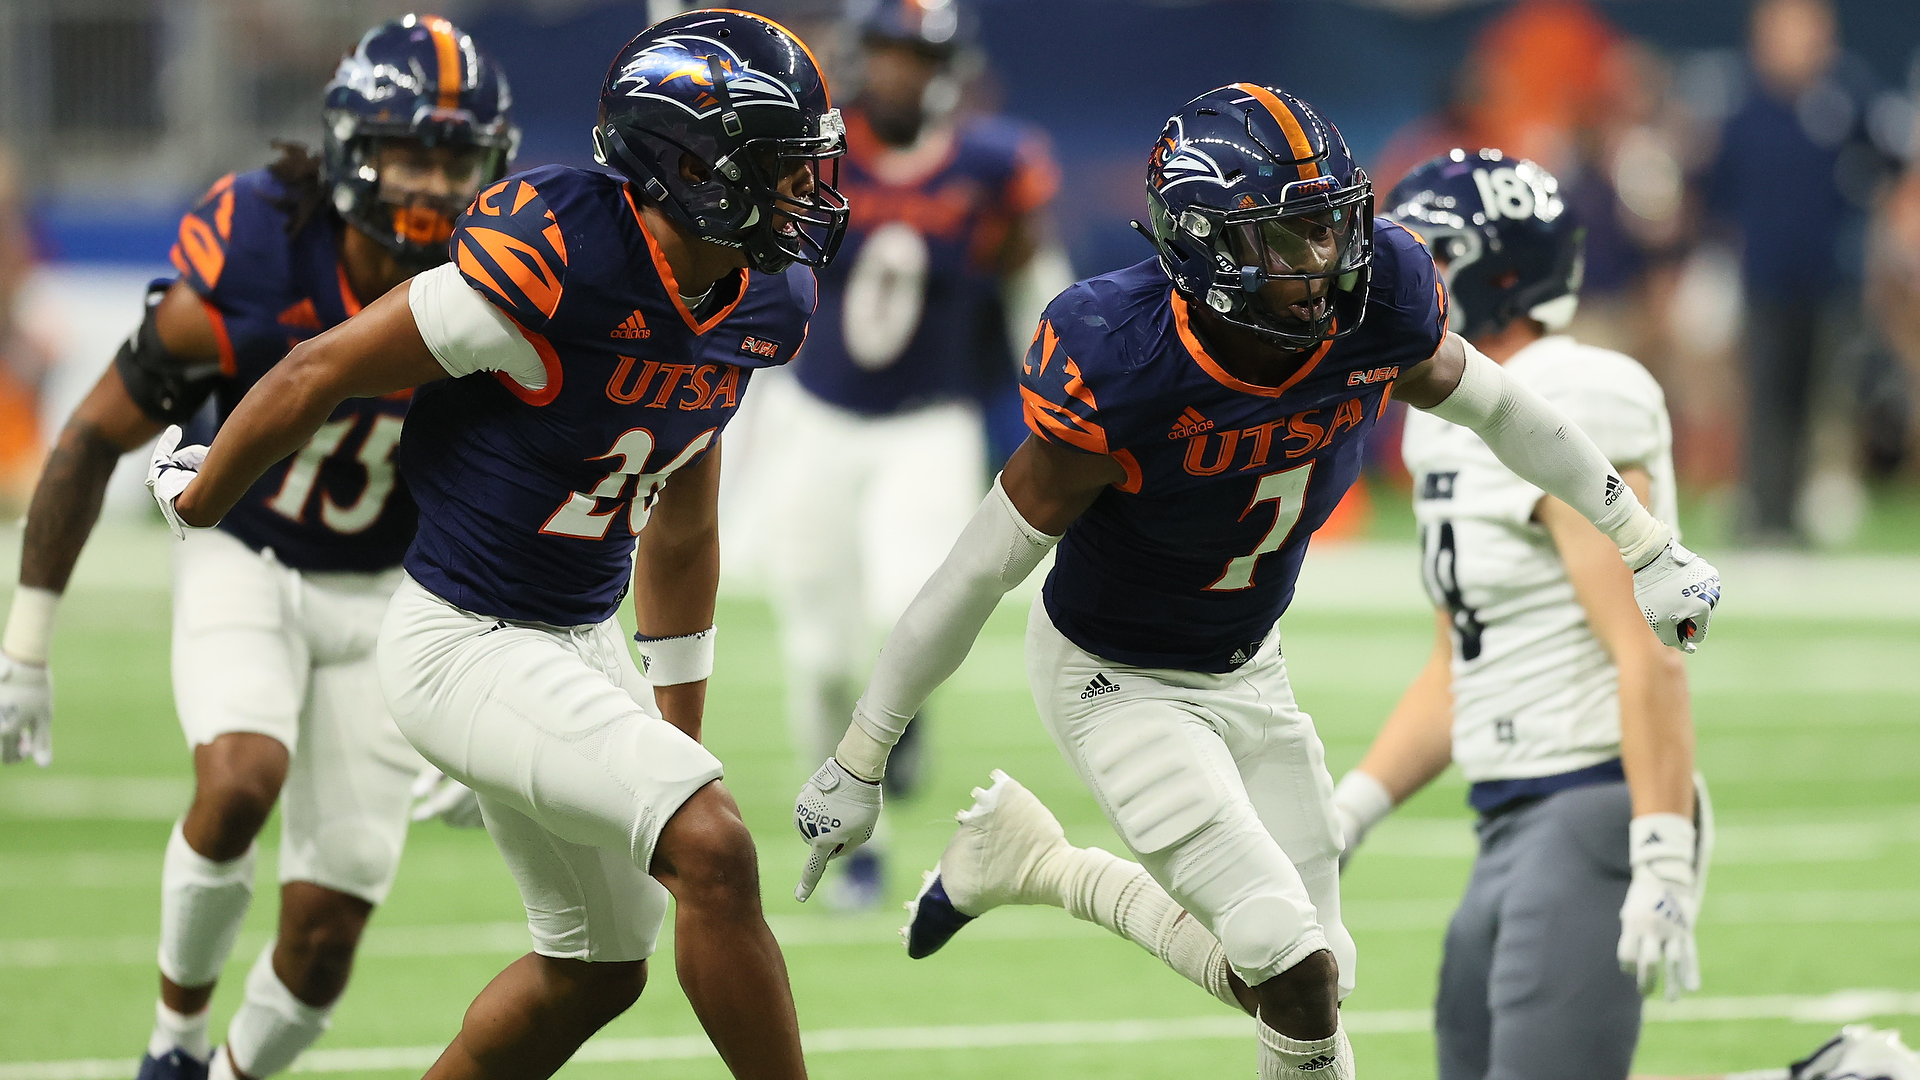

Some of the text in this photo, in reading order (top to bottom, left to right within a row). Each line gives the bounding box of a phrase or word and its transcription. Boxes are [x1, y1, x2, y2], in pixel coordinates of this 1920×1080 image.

[1472, 167, 1535, 220] 18
[843, 220, 929, 372] 0
[610, 327, 651, 339] adidas
[605, 354, 741, 411] UTSA
[1167, 419, 1215, 440] adidas
[1182, 397, 1364, 477] UTSA
[264, 412, 405, 535] 15
[1200, 458, 1317, 592] 7
[1080, 683, 1121, 700] adidas
[796, 803, 842, 828] adidas
